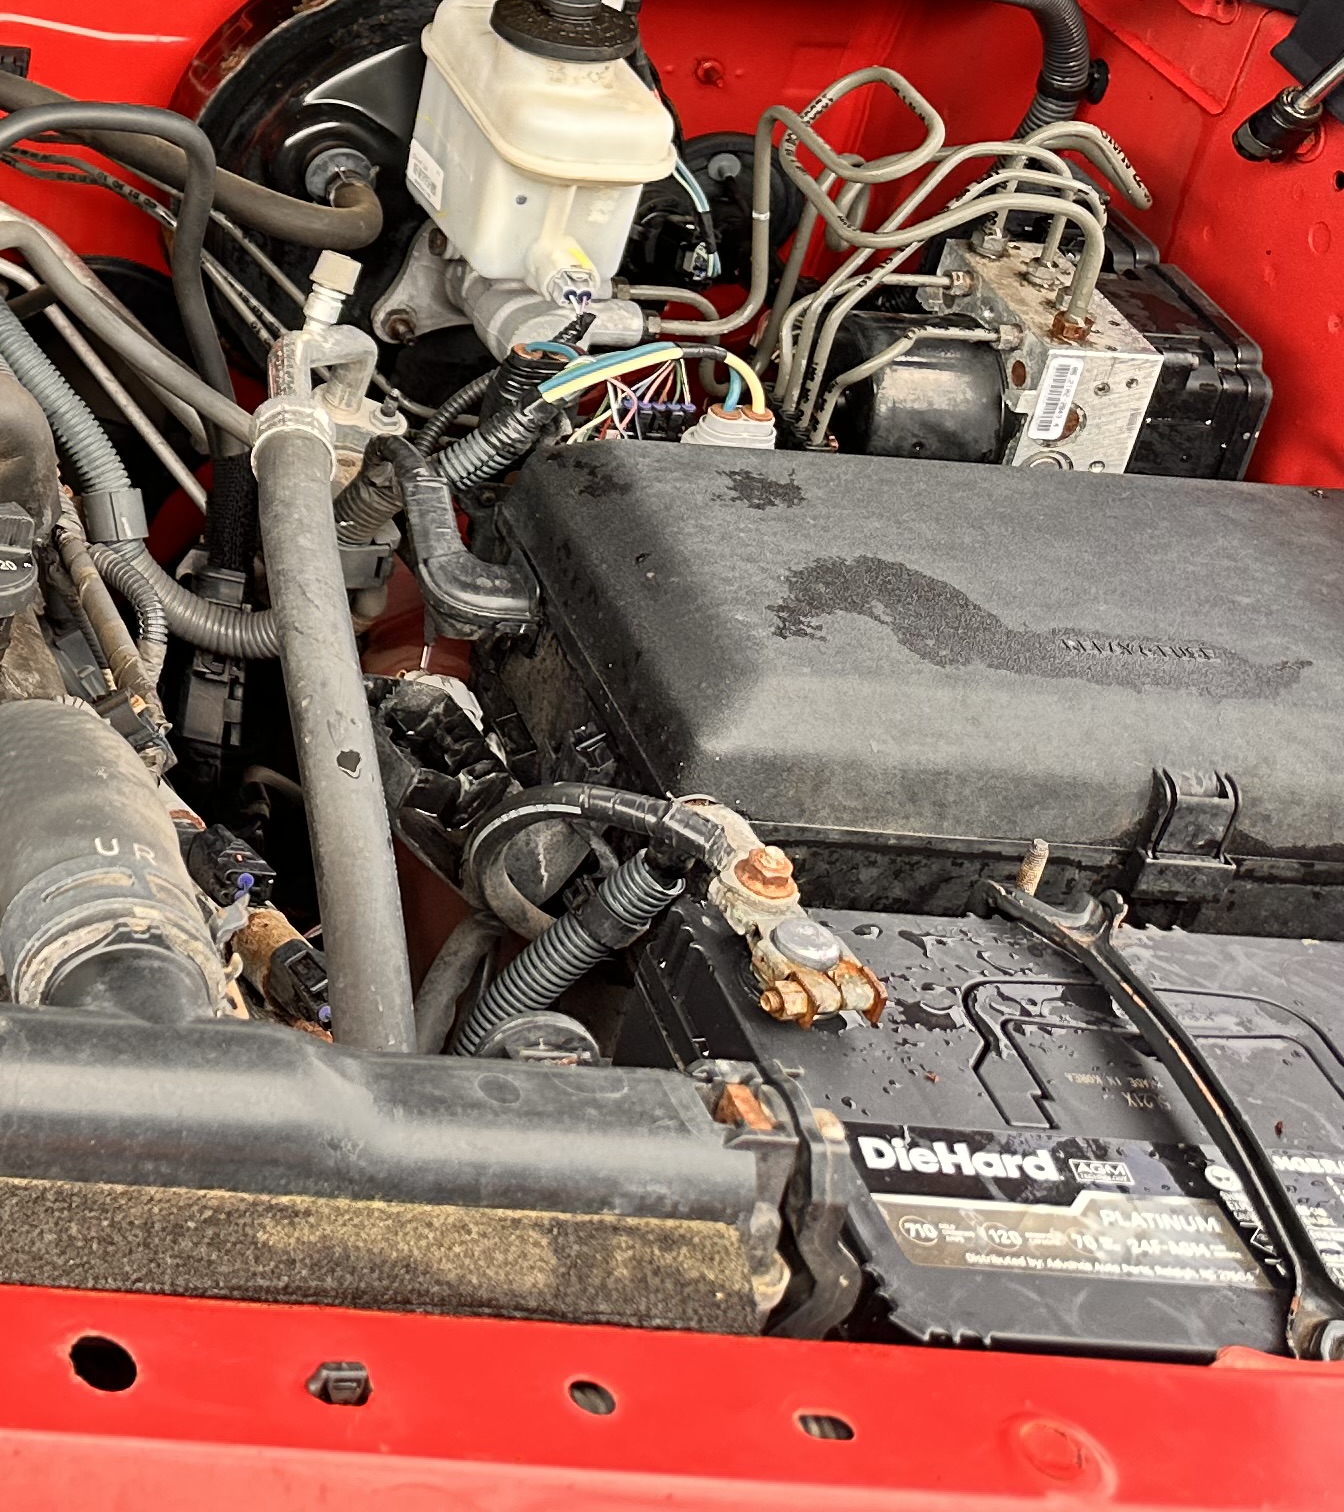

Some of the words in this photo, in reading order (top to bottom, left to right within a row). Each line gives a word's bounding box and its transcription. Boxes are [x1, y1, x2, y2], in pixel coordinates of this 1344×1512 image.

[857, 1136, 1058, 1182] DieHard
[1076, 1161, 1128, 1177] AGM
[904, 1221, 937, 1240] 710
[1100, 1209, 1222, 1234] PLATINUM
[988, 1228, 1021, 1246] 120
